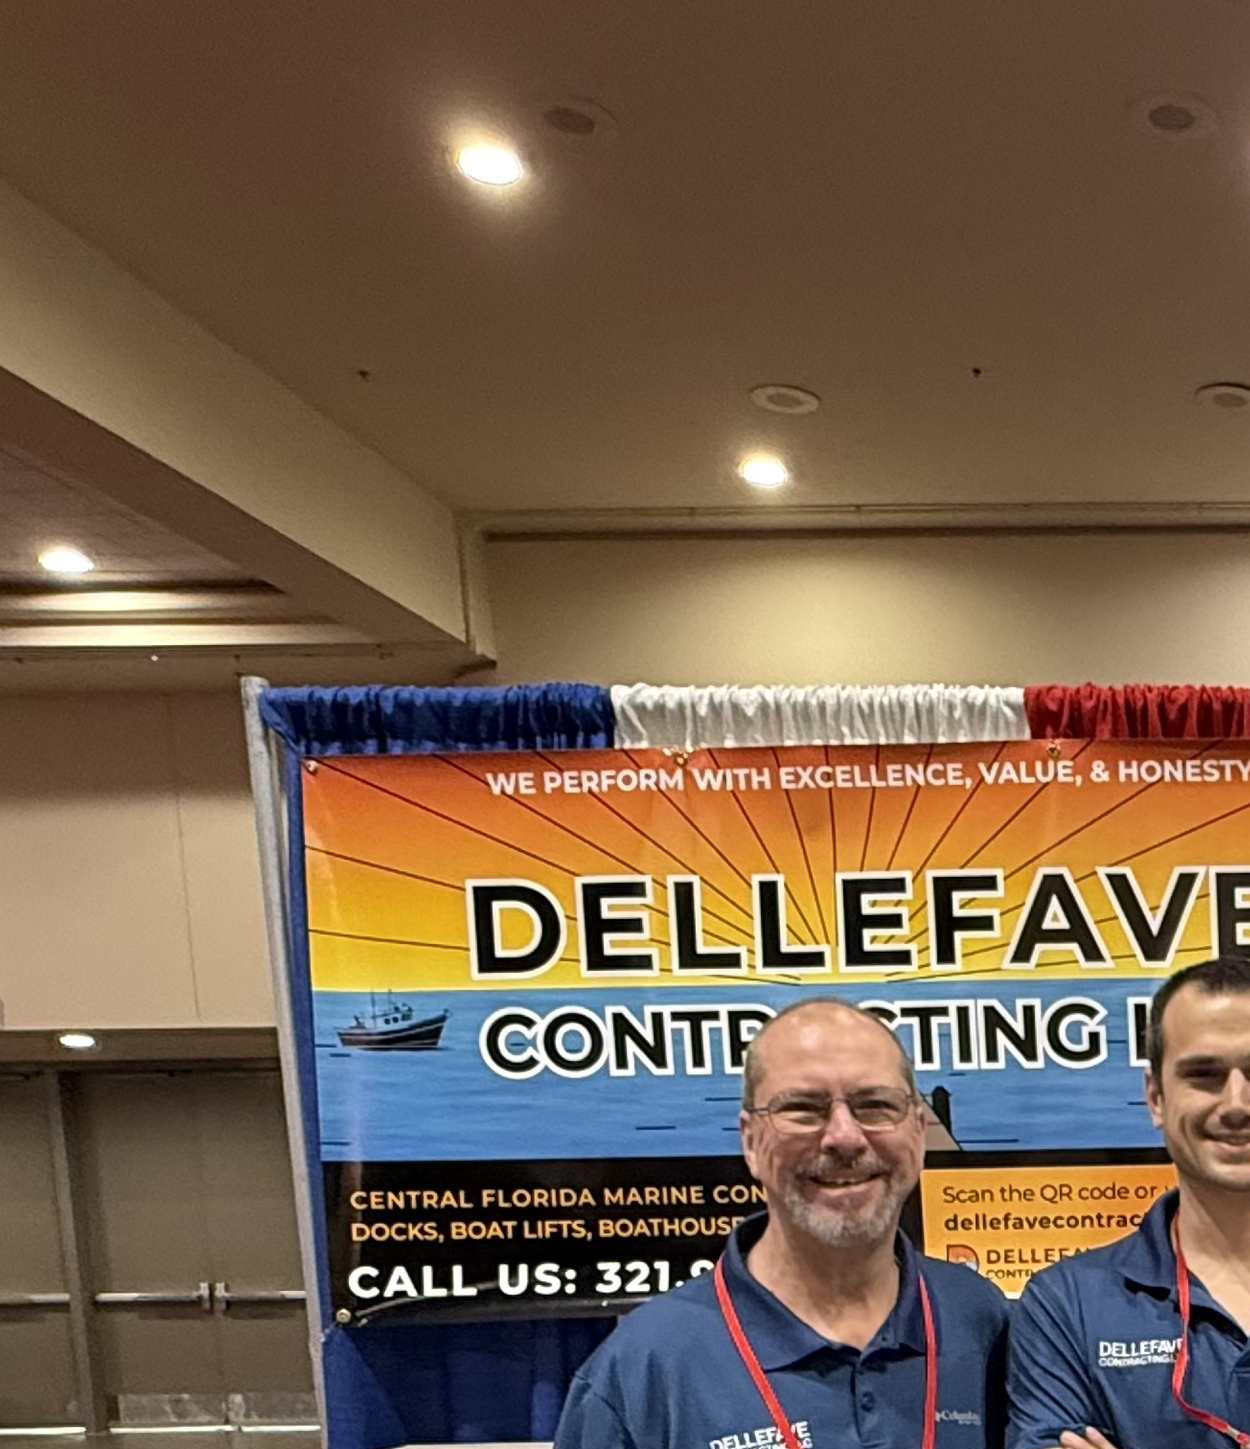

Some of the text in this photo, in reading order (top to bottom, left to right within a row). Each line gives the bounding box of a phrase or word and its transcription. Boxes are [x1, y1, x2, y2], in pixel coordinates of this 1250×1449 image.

[486, 772, 536, 795] WE
[544, 768, 684, 793] PERFORM
[691, 767, 771, 791] WITH
[779, 763, 972, 790] EXCELLENCE,
[978, 761, 1082, 787] VALUE,
[1090, 760, 1110, 783] &
[350, 1190, 473, 1210] CENTRAL
[482, 1187, 596, 1208] FLORIDA
[604, 1186, 705, 1206] MARINE
[943, 1186, 994, 1203] Scan
[1000, 1184, 1035, 1201] the
[1040, 1183, 1072, 1203] QR
[1078, 1183, 1129, 1200] code
[1134, 1185, 1158, 1199] or
[352, 1221, 444, 1243] DOCKS,
[450, 1220, 517, 1240] BOAT
[524, 1219, 592, 1241] LIFTS,
[348, 1264, 478, 1298] CALL
[498, 1263, 577, 1295] US:
